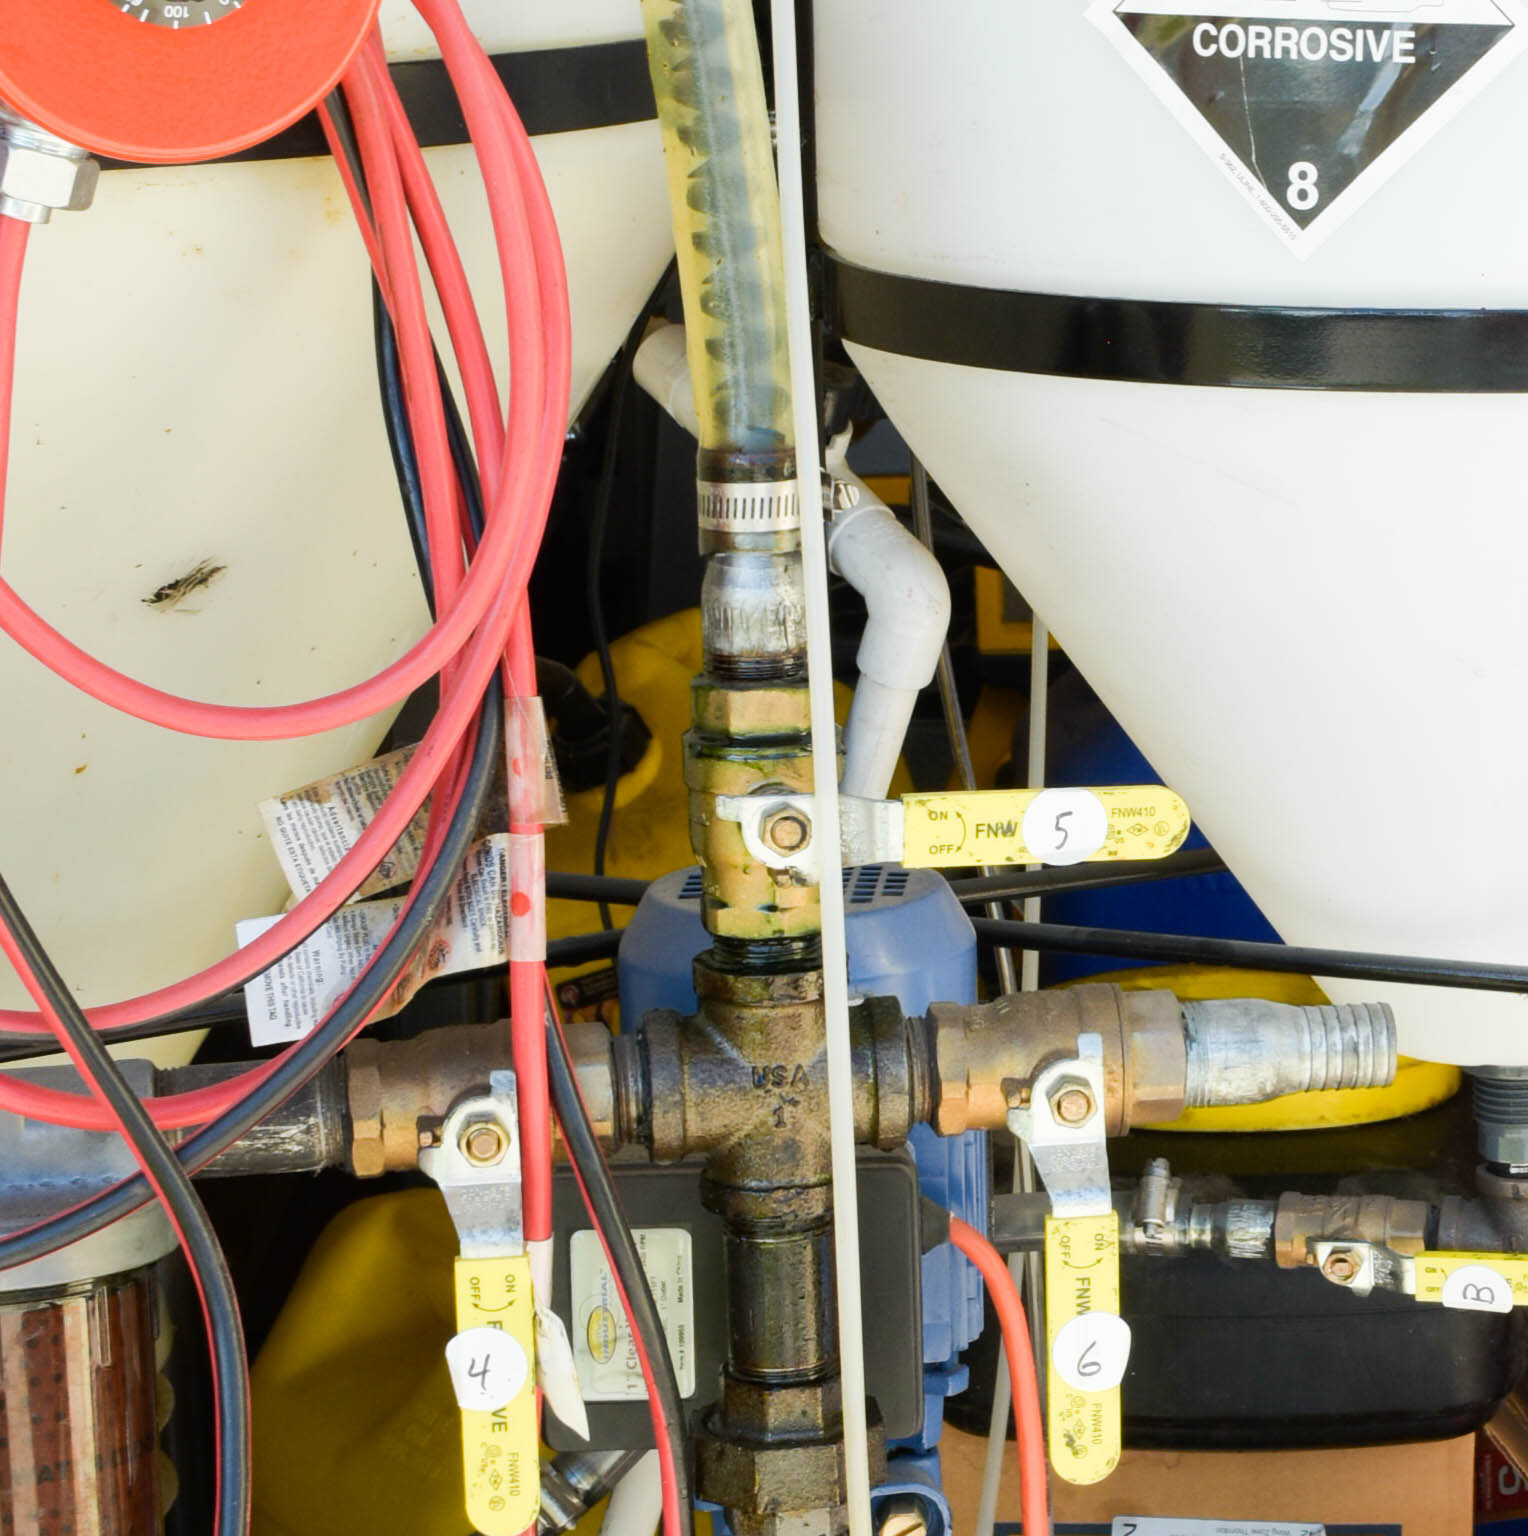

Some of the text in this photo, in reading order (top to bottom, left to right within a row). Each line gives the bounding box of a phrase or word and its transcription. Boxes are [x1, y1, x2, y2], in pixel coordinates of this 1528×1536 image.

[164, 5, 189, 18] 100
[1193, 22, 1416, 64] CORROSIVE
[1286, 161, 1319, 210] 8
[929, 809, 948, 821] ON
[1112, 806, 1156, 818] FNW410
[976, 822, 1018, 839] FNW
[1054, 810, 1074, 850] 5
[929, 844, 954, 855] OFF
[1060, 1235, 1072, 1259] OFF
[1094, 1232, 1105, 1252] ON
[468, 1276, 480, 1302] OFF
[505, 1273, 516, 1293] ON
[1462, 1282, 1494, 1304] B
[1077, 1340, 1102, 1377] 6
[467, 1353, 491, 1389] 4
[1091, 1402, 1102, 1445] FNW410
[507, 1452, 519, 1497] FNW410
